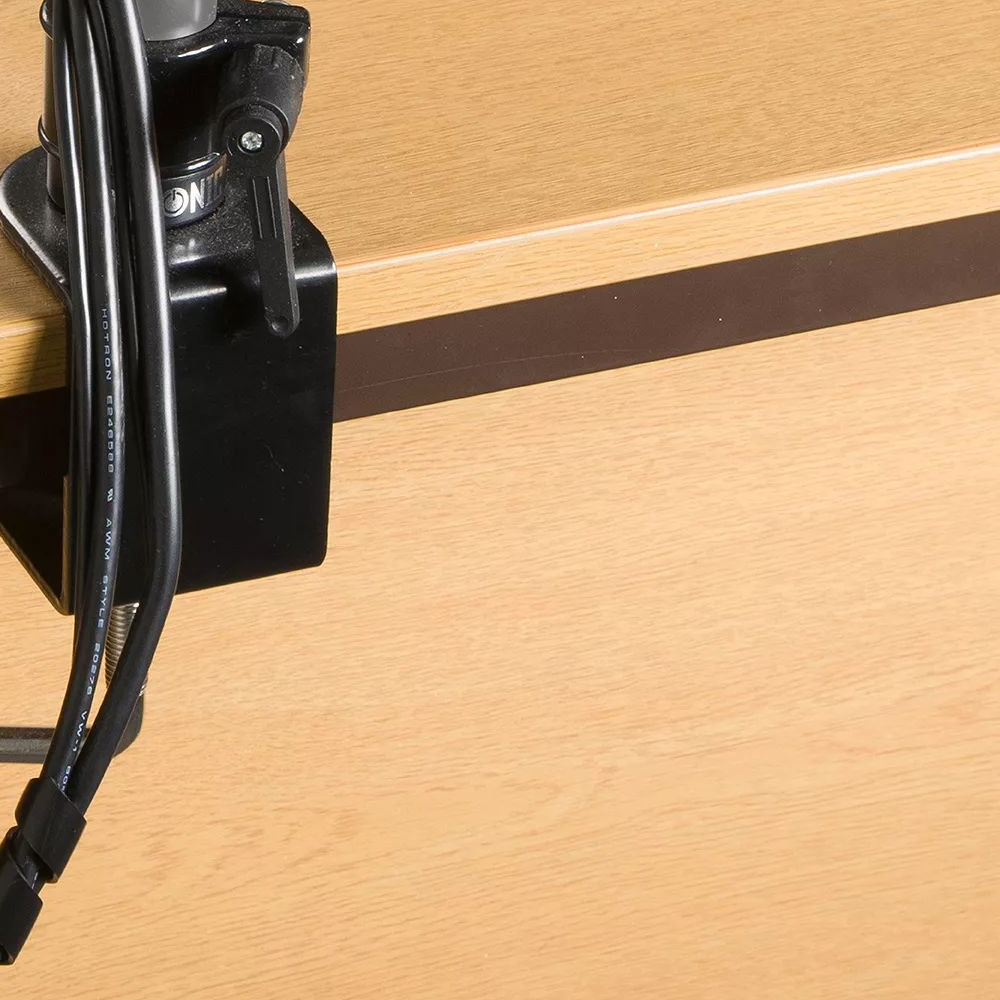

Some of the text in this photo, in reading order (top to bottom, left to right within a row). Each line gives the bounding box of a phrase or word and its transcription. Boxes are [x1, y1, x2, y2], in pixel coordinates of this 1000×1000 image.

[101, 308, 112, 381] HOTRON
[103, 518, 112, 560] AWM
[97, 575, 109, 629] STYLE
